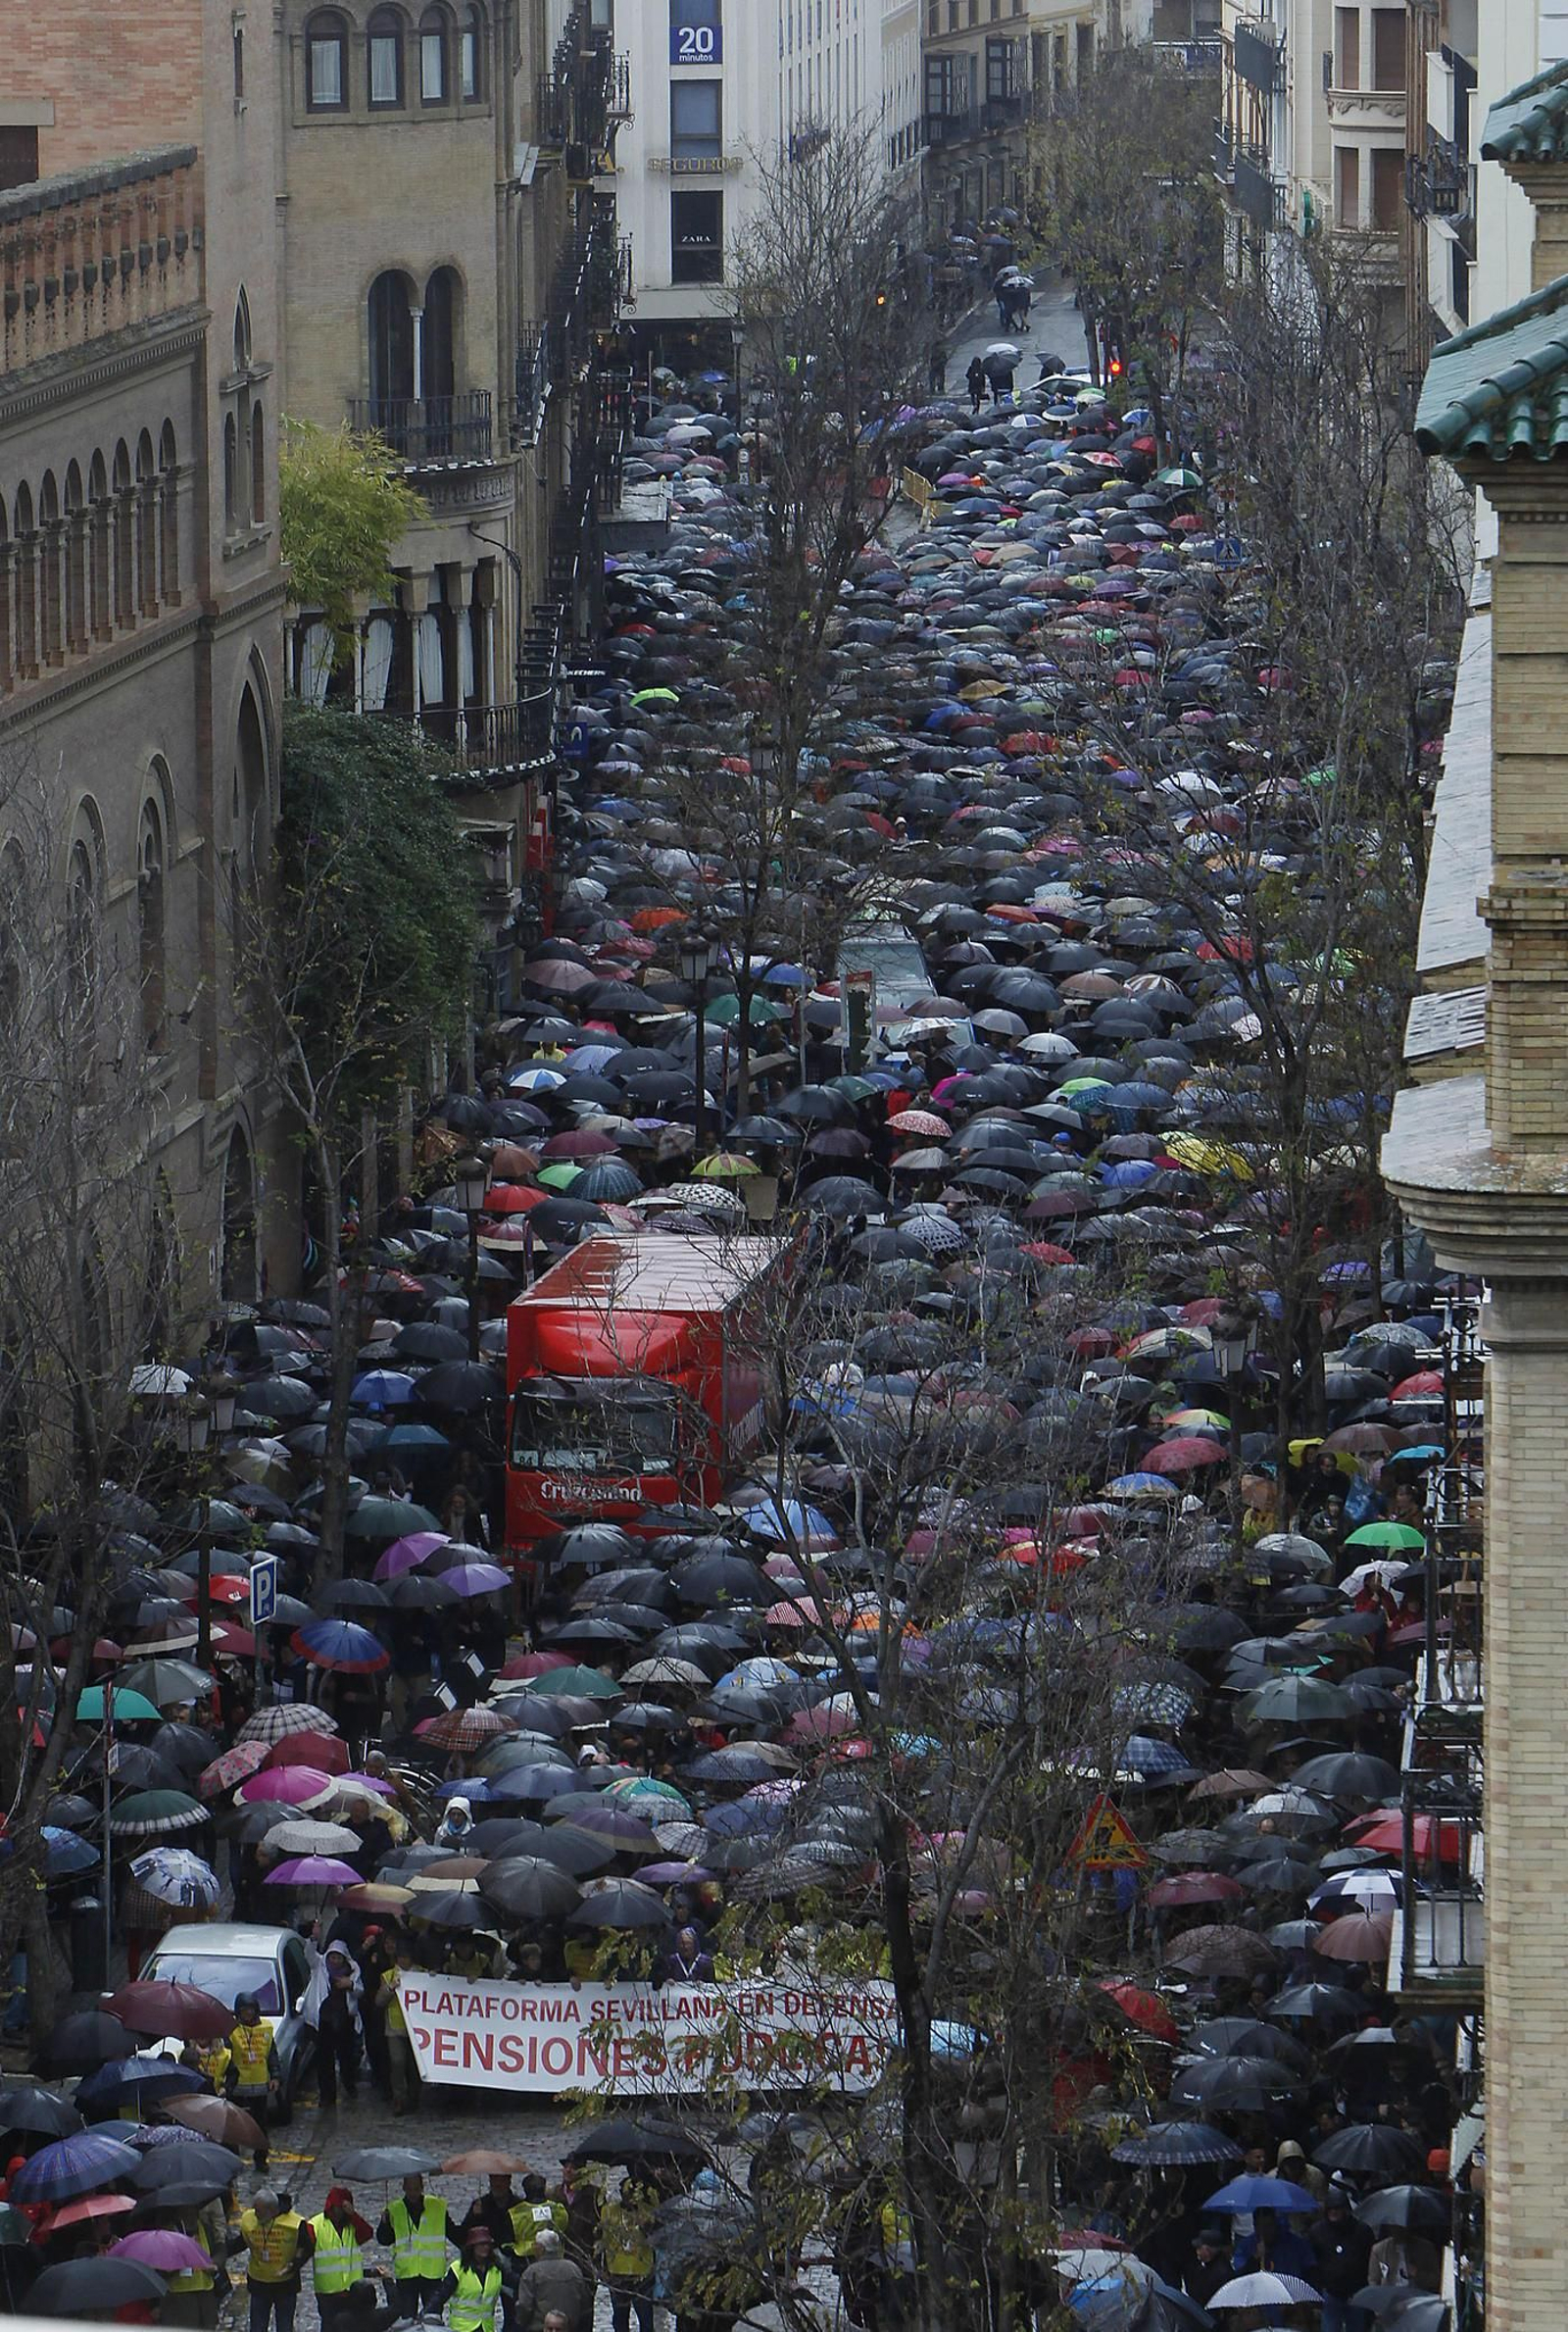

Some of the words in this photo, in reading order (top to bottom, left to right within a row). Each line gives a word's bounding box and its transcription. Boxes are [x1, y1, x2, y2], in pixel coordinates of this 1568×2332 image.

[678, 26, 714, 53] 20
[647, 156, 744, 174] SEGUROS
[257, 1570, 271, 1615] P
[404, 1989, 581, 2023] PLATAFORMA
[591, 1996, 728, 2023] SEVILLANA
[738, 1992, 774, 2016] EN
[413, 2027, 668, 2077] PENSIONES
